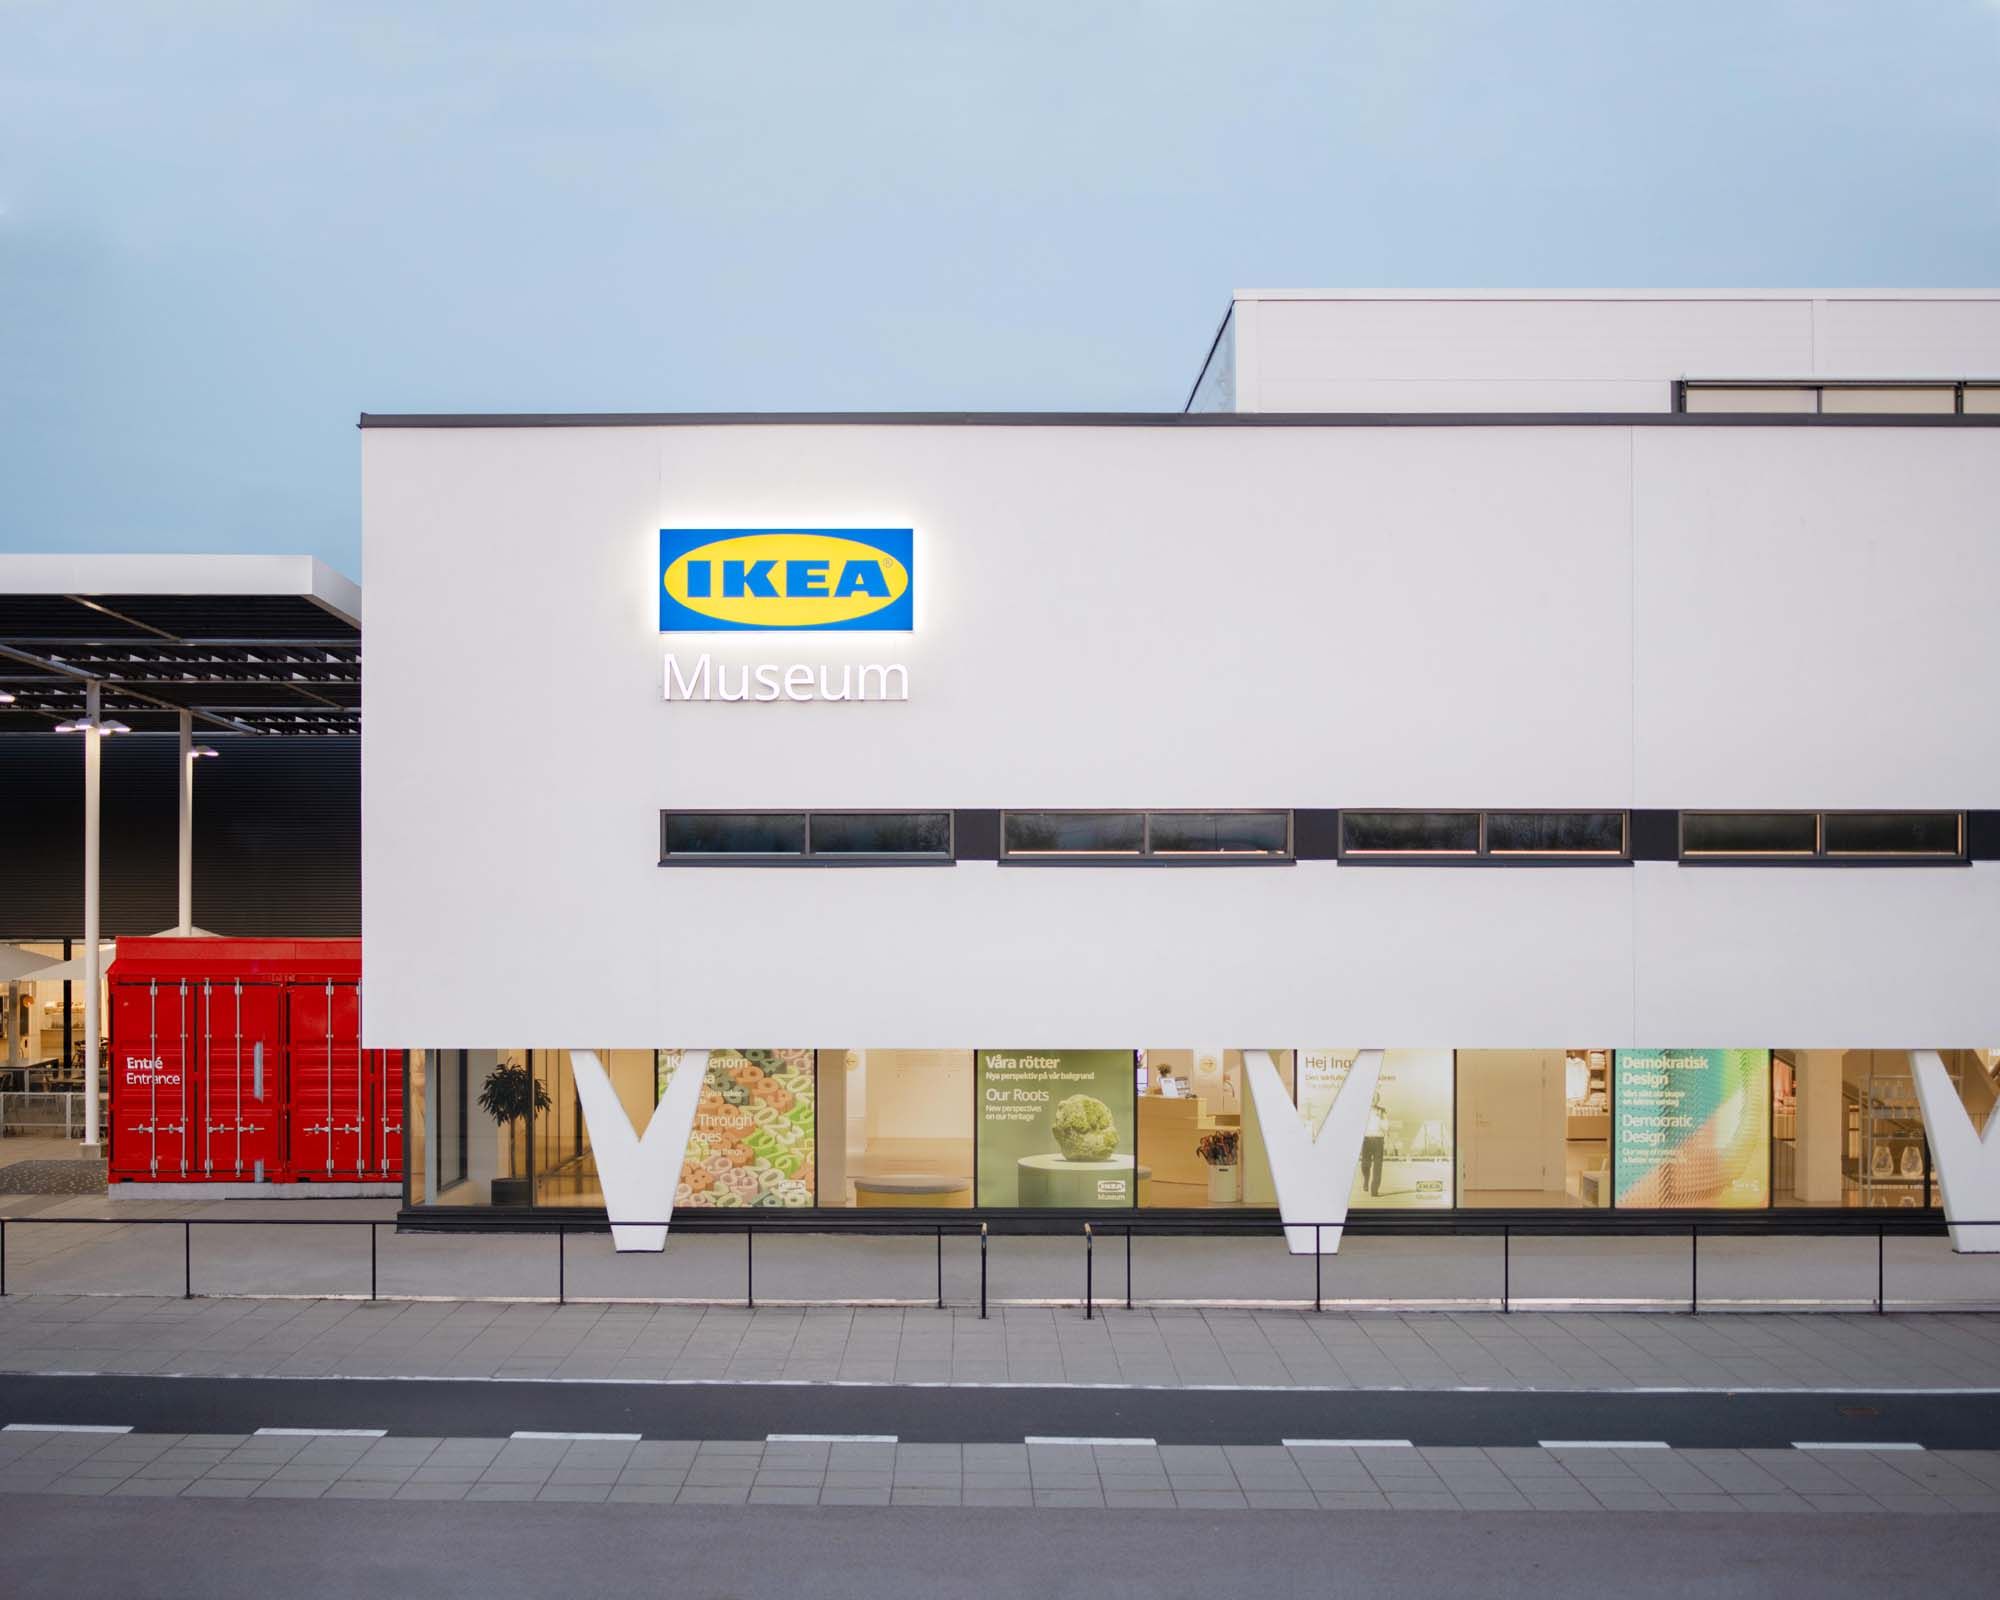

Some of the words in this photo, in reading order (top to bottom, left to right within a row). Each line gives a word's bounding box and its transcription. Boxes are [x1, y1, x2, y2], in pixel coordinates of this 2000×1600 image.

[663, 653, 908, 701] Museum
[708, 1058, 749, 1069] enom
[985, 1054, 1017, 1069] Våra
[1019, 1055, 1061, 1069] rötter
[1305, 1056, 1327, 1072] Hej
[1330, 1056, 1353, 1072] Ing
[1623, 1056, 1709, 1070] Demokratisk
[127, 1072, 181, 1085] Entrance
[1623, 1072, 1669, 1089] Design
[985, 1088, 1011, 1102] Our
[1013, 1088, 1050, 1102] Roots
[700, 1113, 754, 1130] Through
[1623, 1114, 1694, 1128] Democratic
[1623, 1130, 1666, 1147] Design
